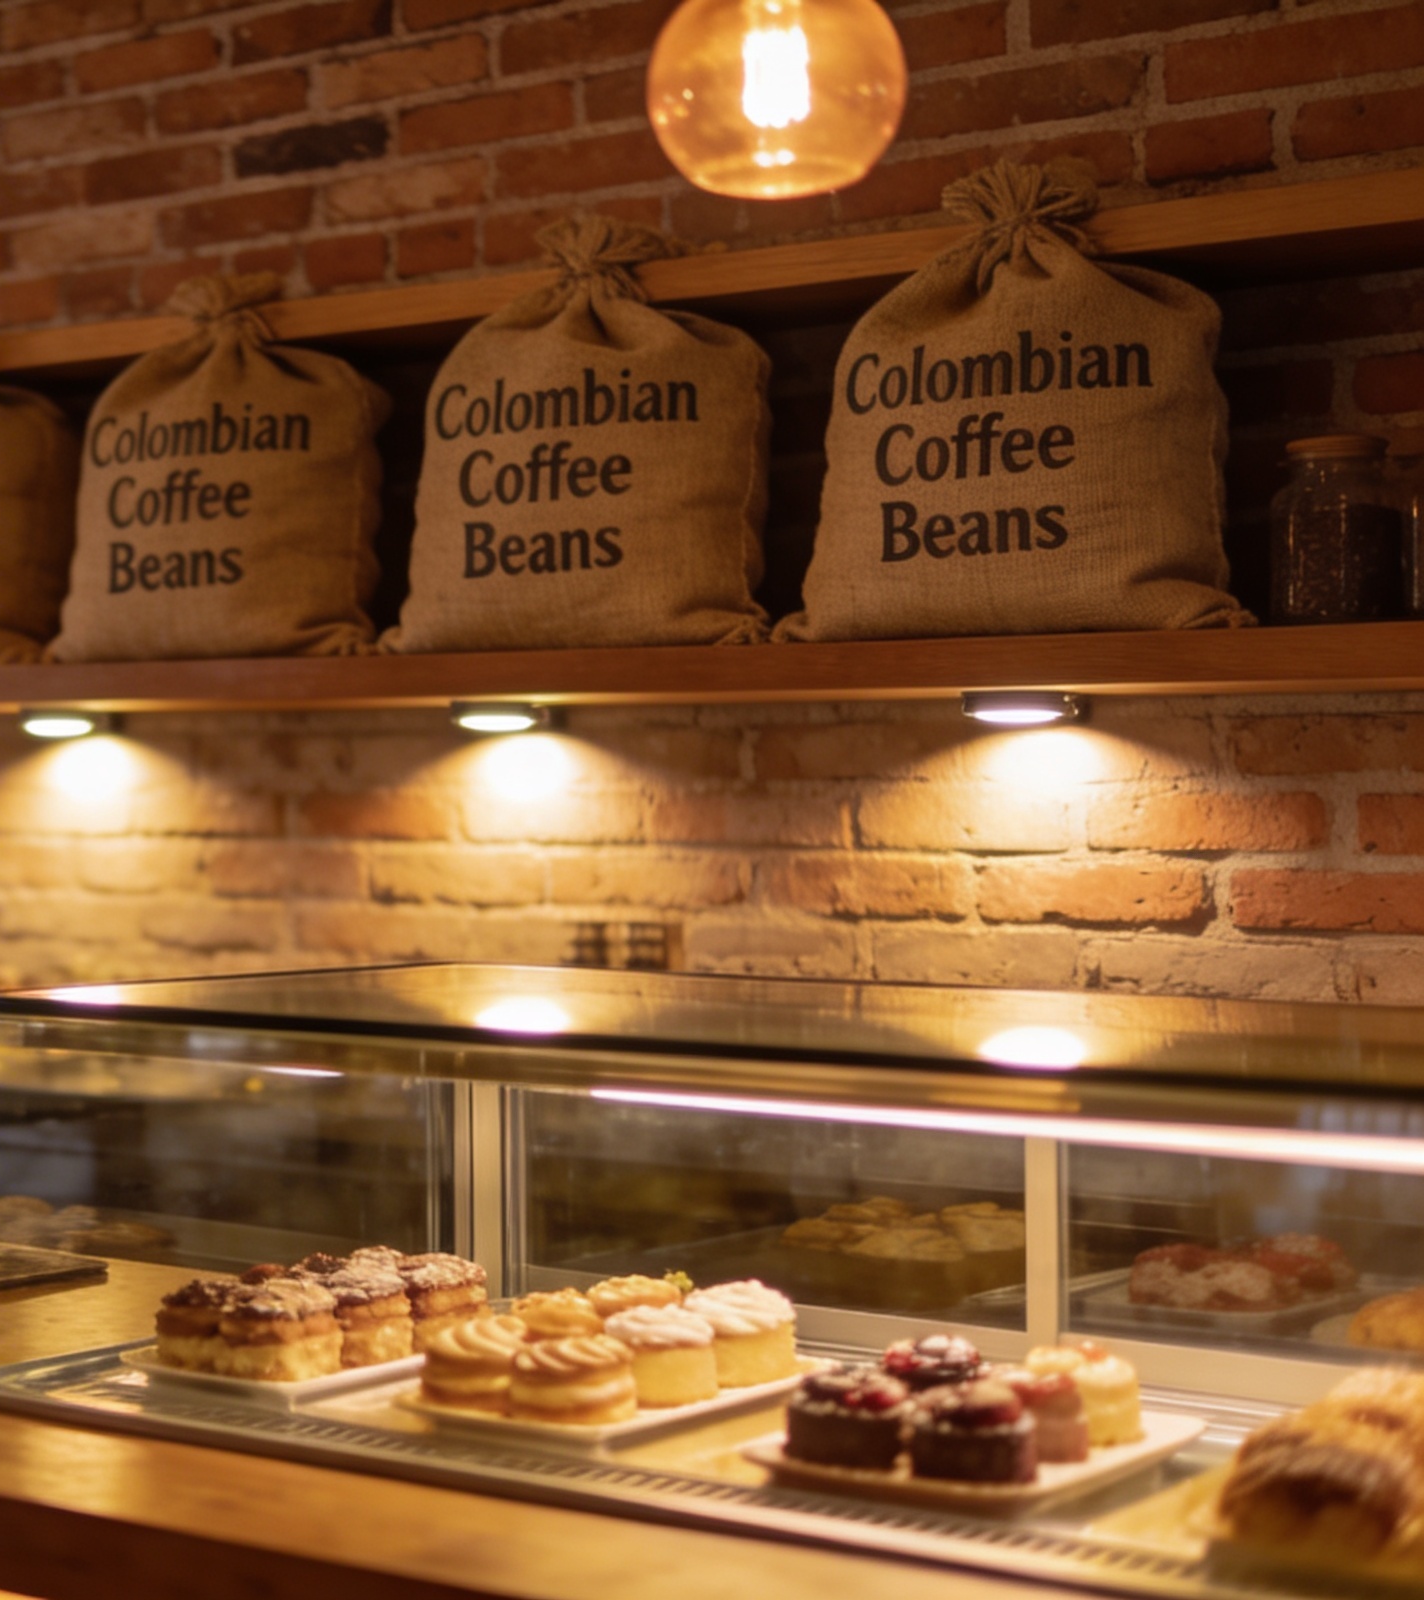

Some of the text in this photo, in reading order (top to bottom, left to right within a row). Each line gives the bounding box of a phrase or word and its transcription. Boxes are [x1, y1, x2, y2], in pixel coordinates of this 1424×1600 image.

[435, 368, 699, 440] Colombian
[846, 330, 1153, 415] Colombian
[91, 403, 311, 468] Colombian
[875, 411, 1075, 486] Coffee
[108, 469, 251, 529] Coffee
[459, 441, 632, 507] Coffee
[463, 521, 623, 578] Beans
[880, 501, 1068, 562] Beans
[108, 542, 244, 594] Beans
